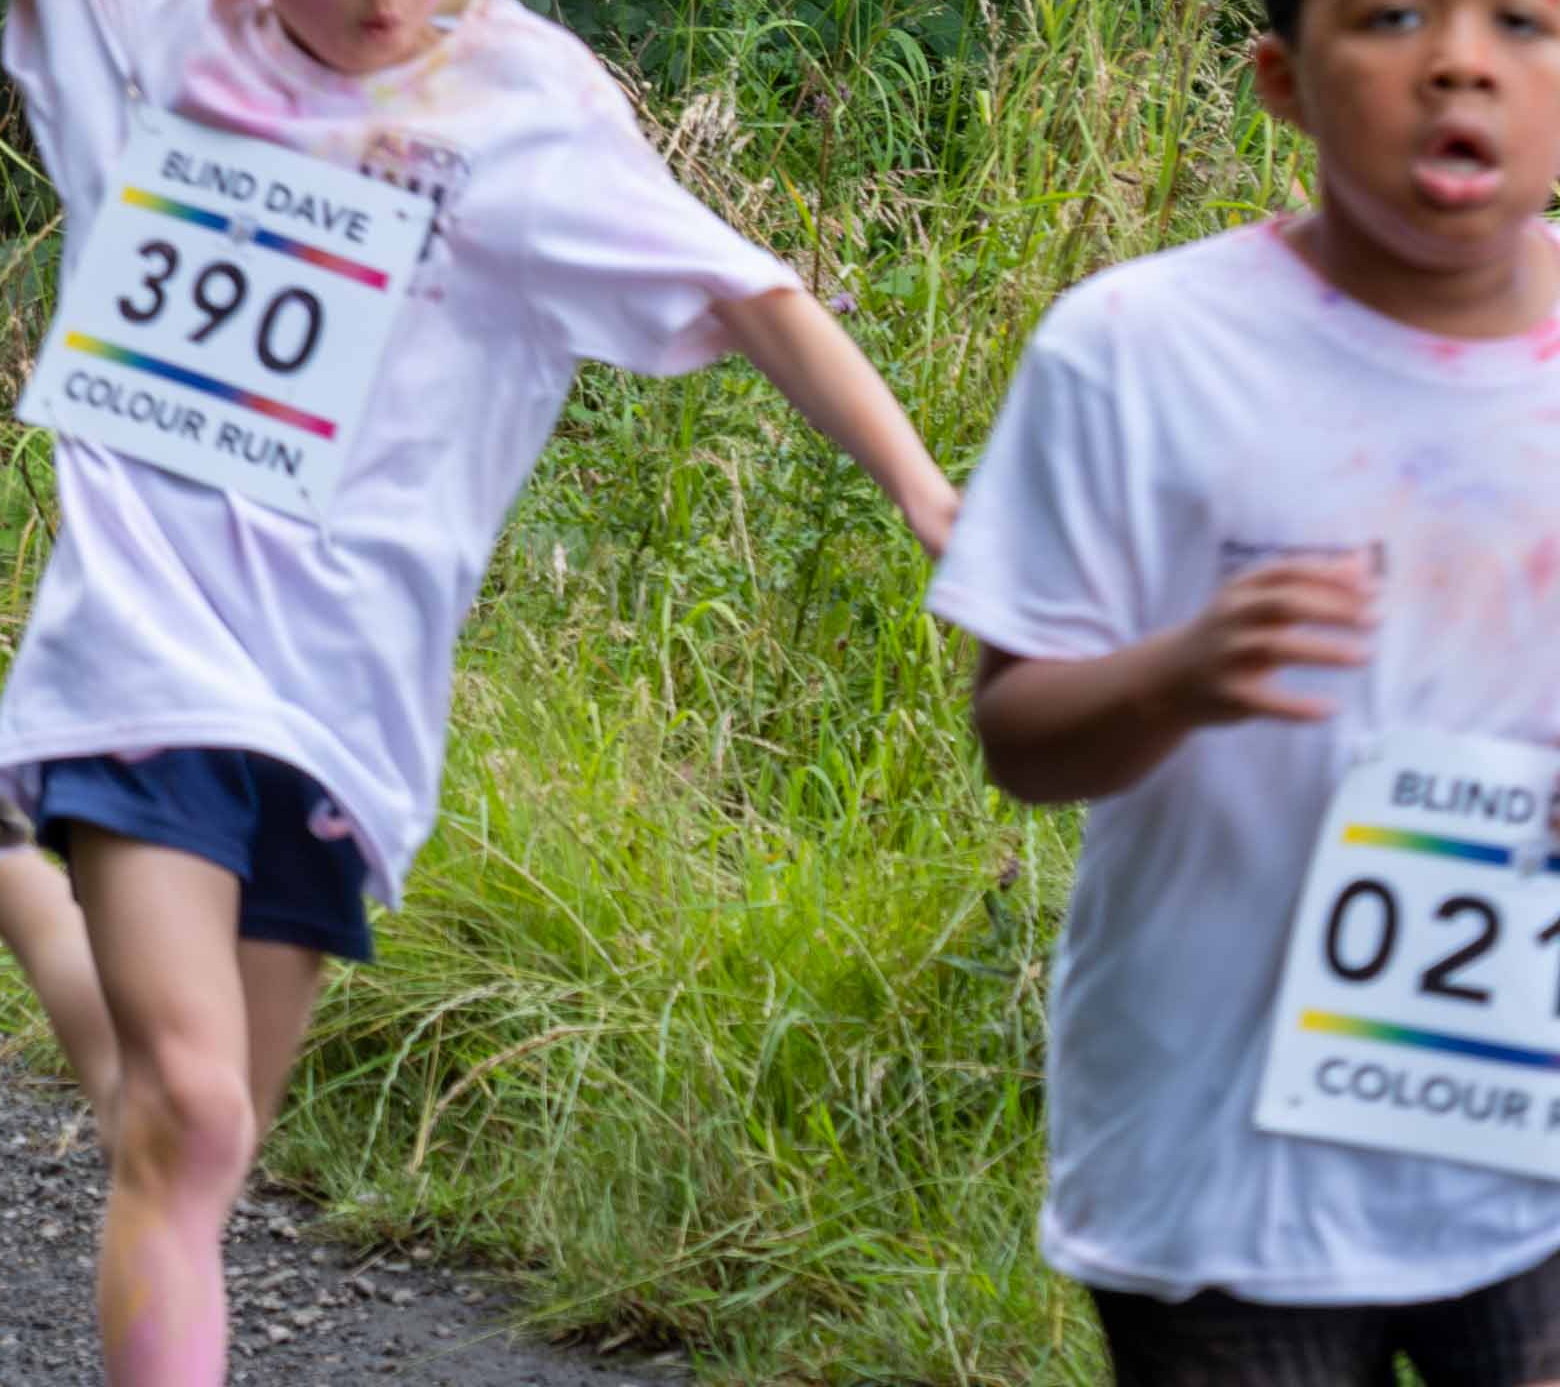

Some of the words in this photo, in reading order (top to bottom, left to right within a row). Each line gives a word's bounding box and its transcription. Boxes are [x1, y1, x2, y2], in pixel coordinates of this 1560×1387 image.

[160, 148, 257, 202] BLIND
[264, 181, 370, 246] DAVE
[116, 237, 327, 376] 390
[64, 370, 208, 444] COLOUR
[215, 422, 304, 478] RUN
[1390, 768, 1536, 825] BLIND
[1315, 1055, 1530, 1124] COLOUR
